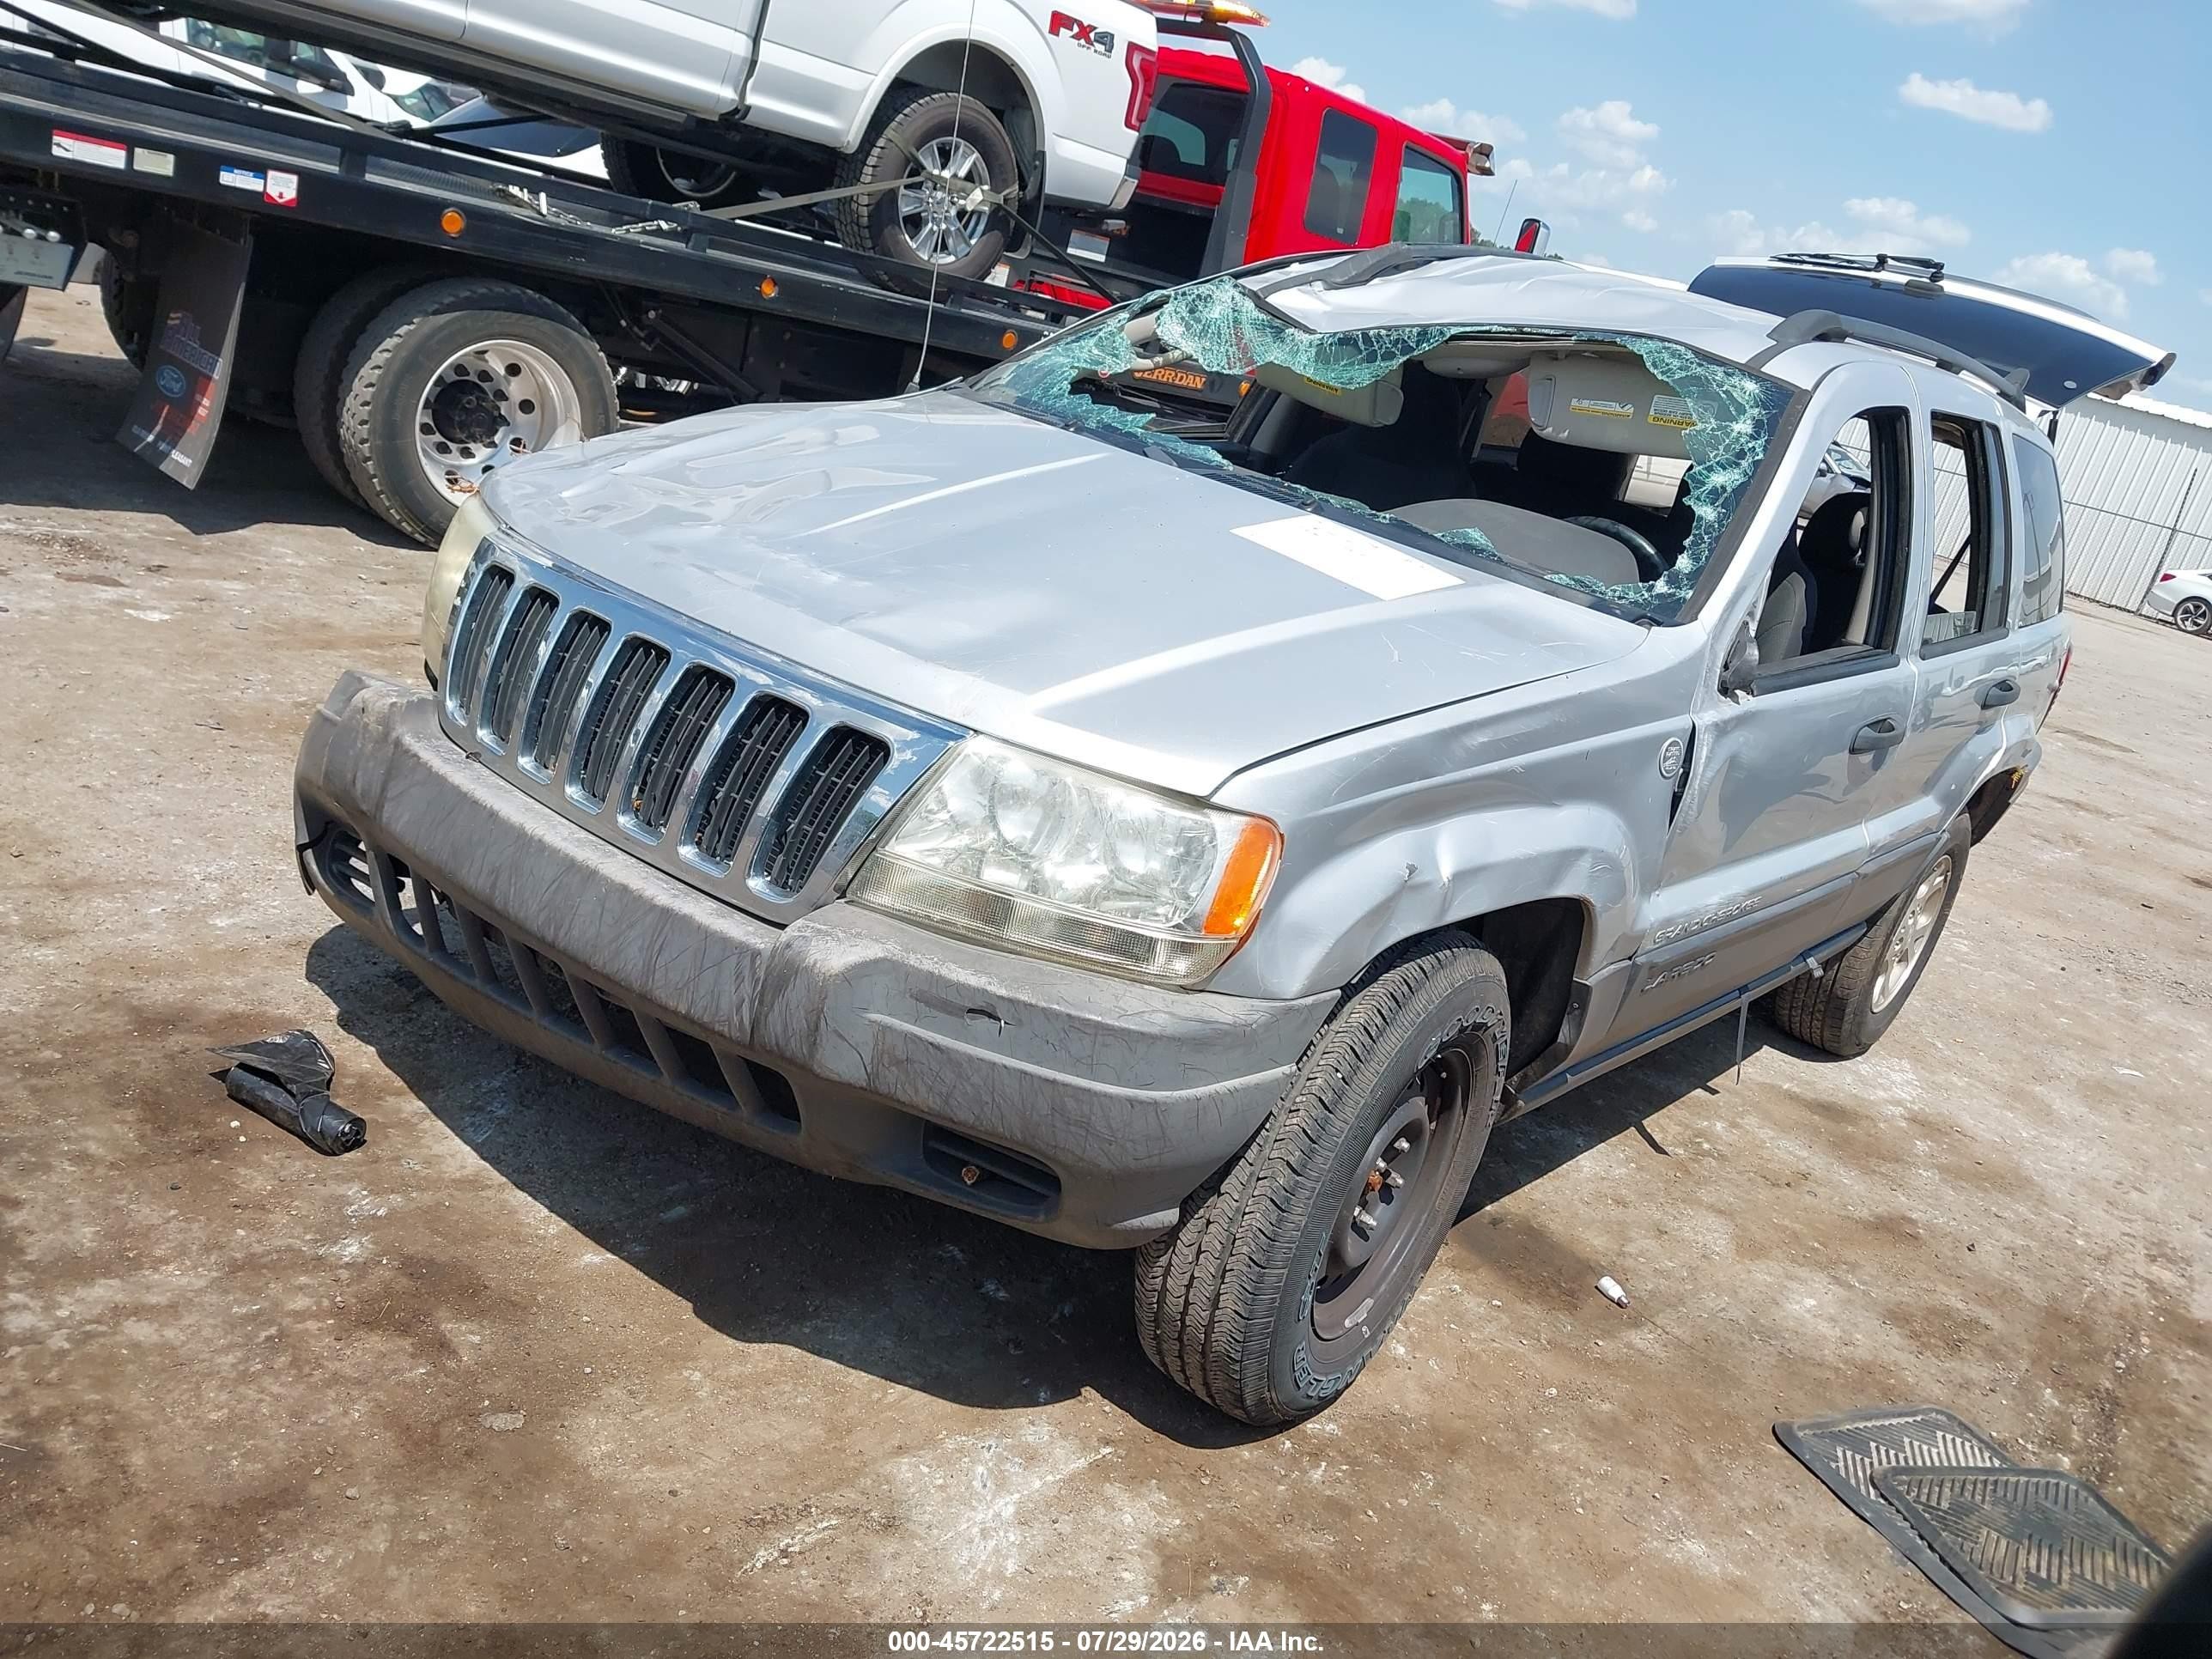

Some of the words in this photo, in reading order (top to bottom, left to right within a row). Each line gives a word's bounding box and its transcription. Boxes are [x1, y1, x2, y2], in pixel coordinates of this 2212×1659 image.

[1048, 9, 1115, 54] FX4
[1077, 41, 1092, 52] OFF
[1093, 48, 1113, 59] ROAD
[1414, 1004, 1509, 1129] GOODYEAR
